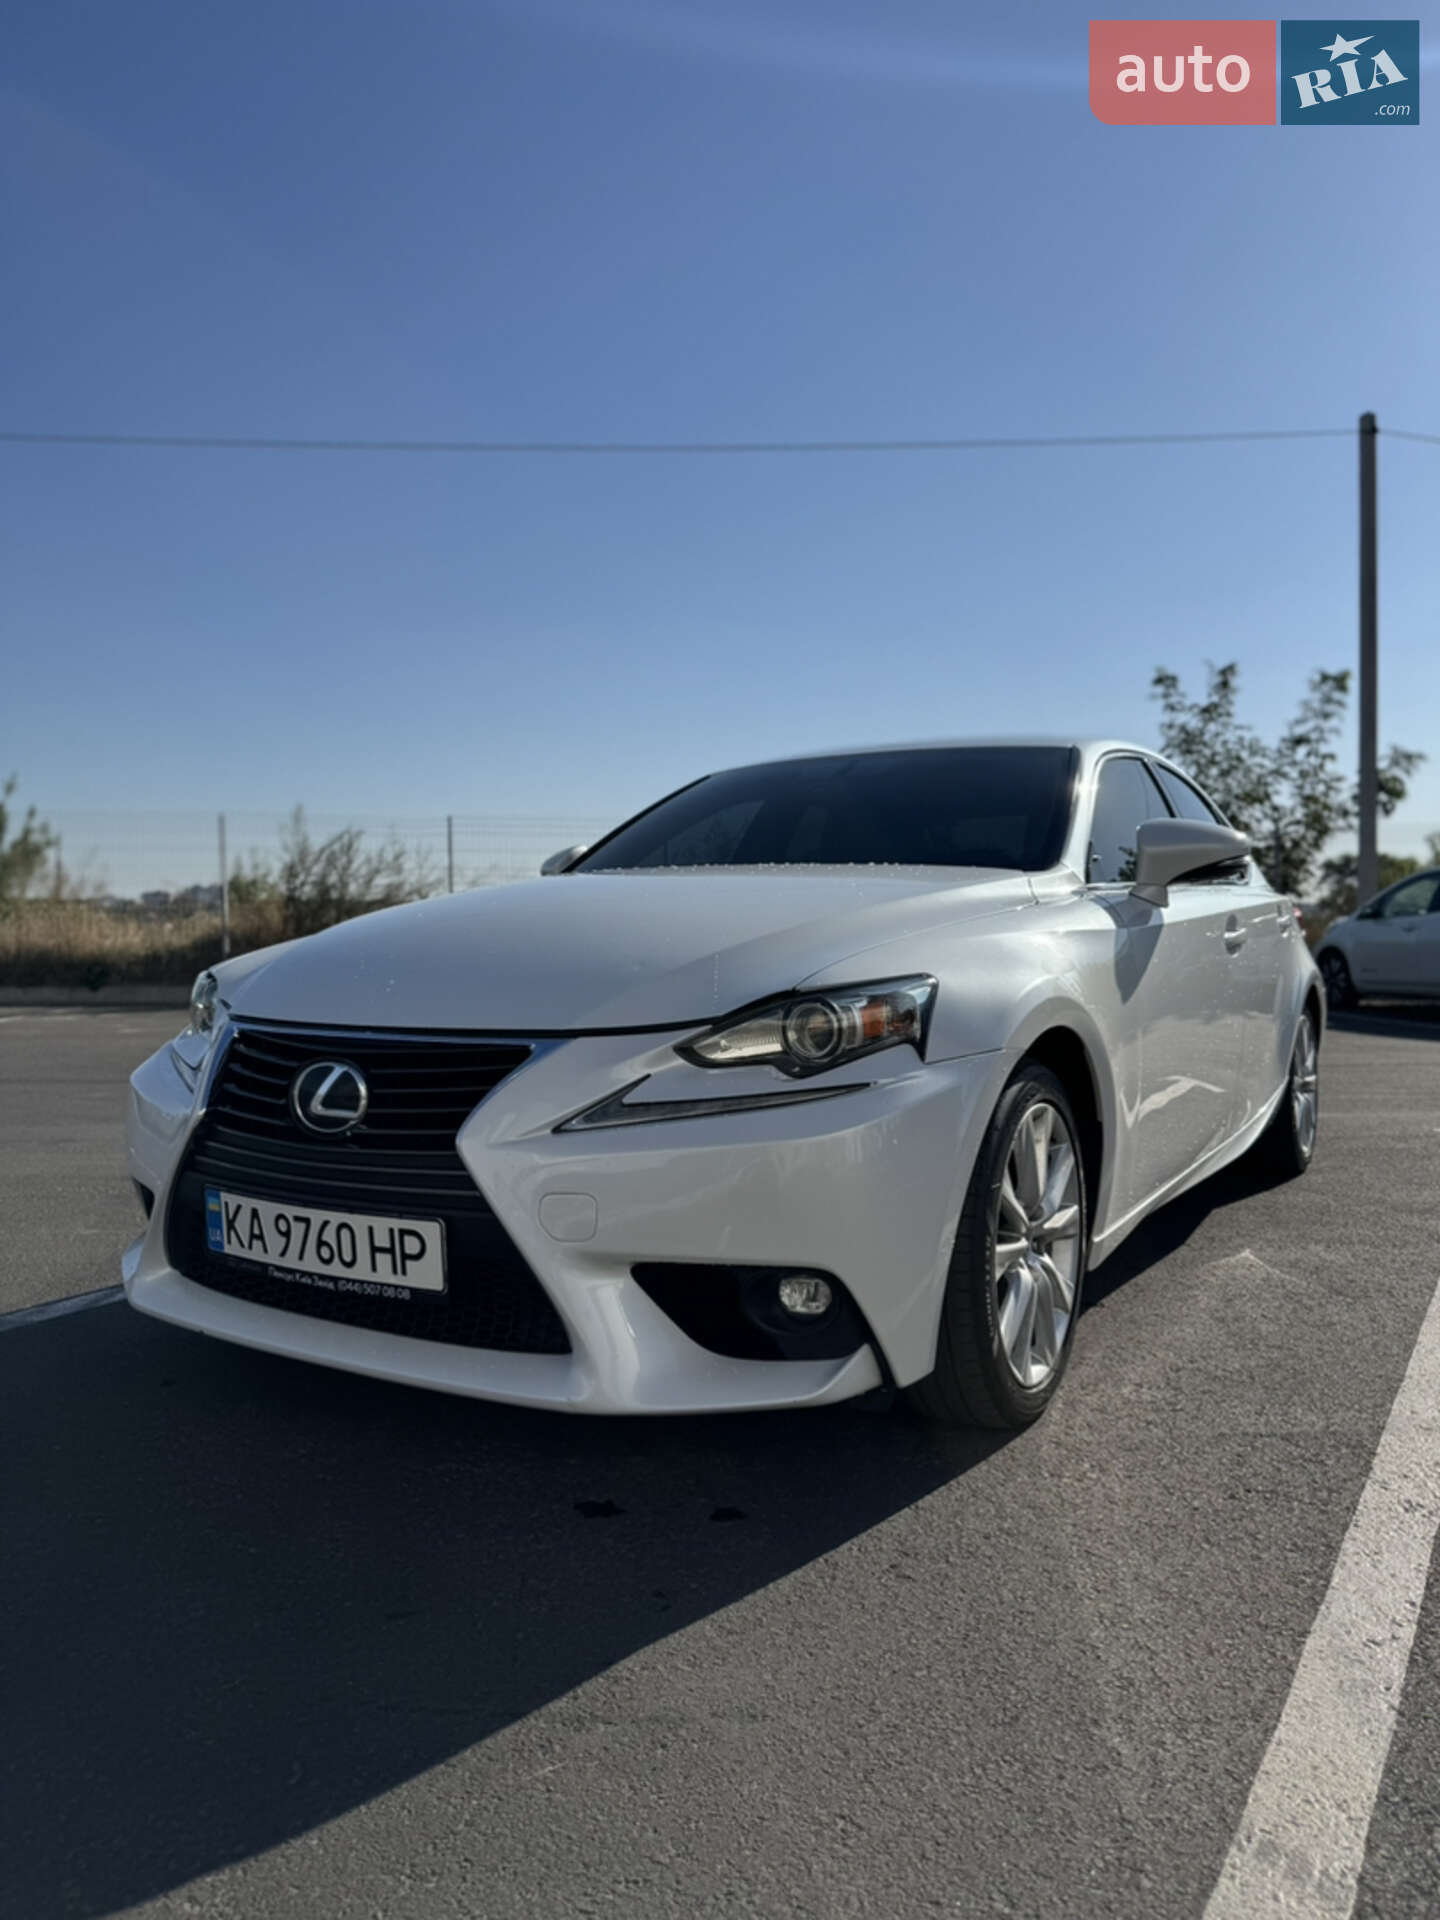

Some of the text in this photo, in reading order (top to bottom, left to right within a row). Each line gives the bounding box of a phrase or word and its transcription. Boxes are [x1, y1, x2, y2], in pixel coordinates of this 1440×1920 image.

[223, 1201, 427, 1277] KA 9760 HP
